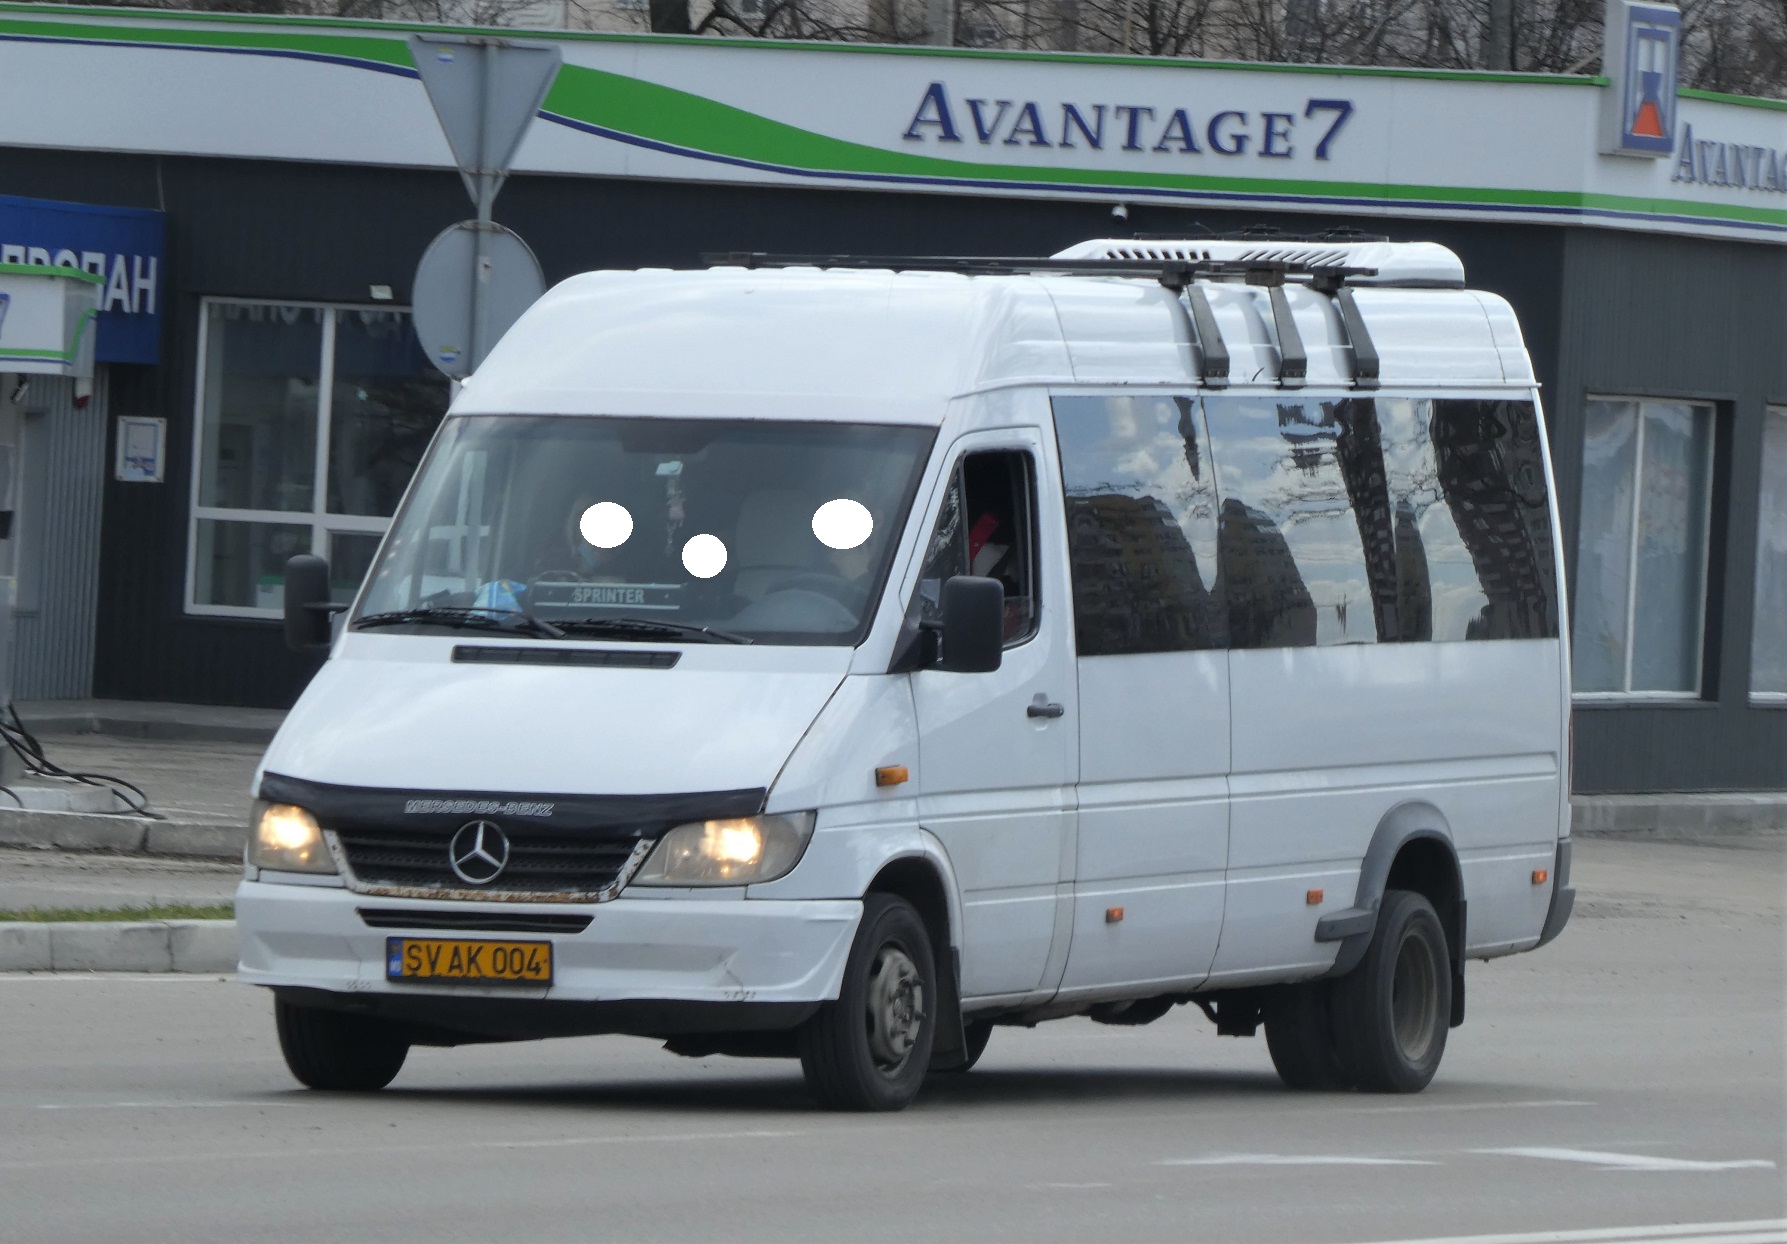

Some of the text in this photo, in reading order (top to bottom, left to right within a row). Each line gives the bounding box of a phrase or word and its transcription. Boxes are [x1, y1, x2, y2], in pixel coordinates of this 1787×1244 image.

[903, 80, 1354, 161] AVANTAGE7
[1671, 121, 1787, 193] AVANTA
[573, 588, 645, 603] SPRINTER
[492, 946, 542, 976] 004
